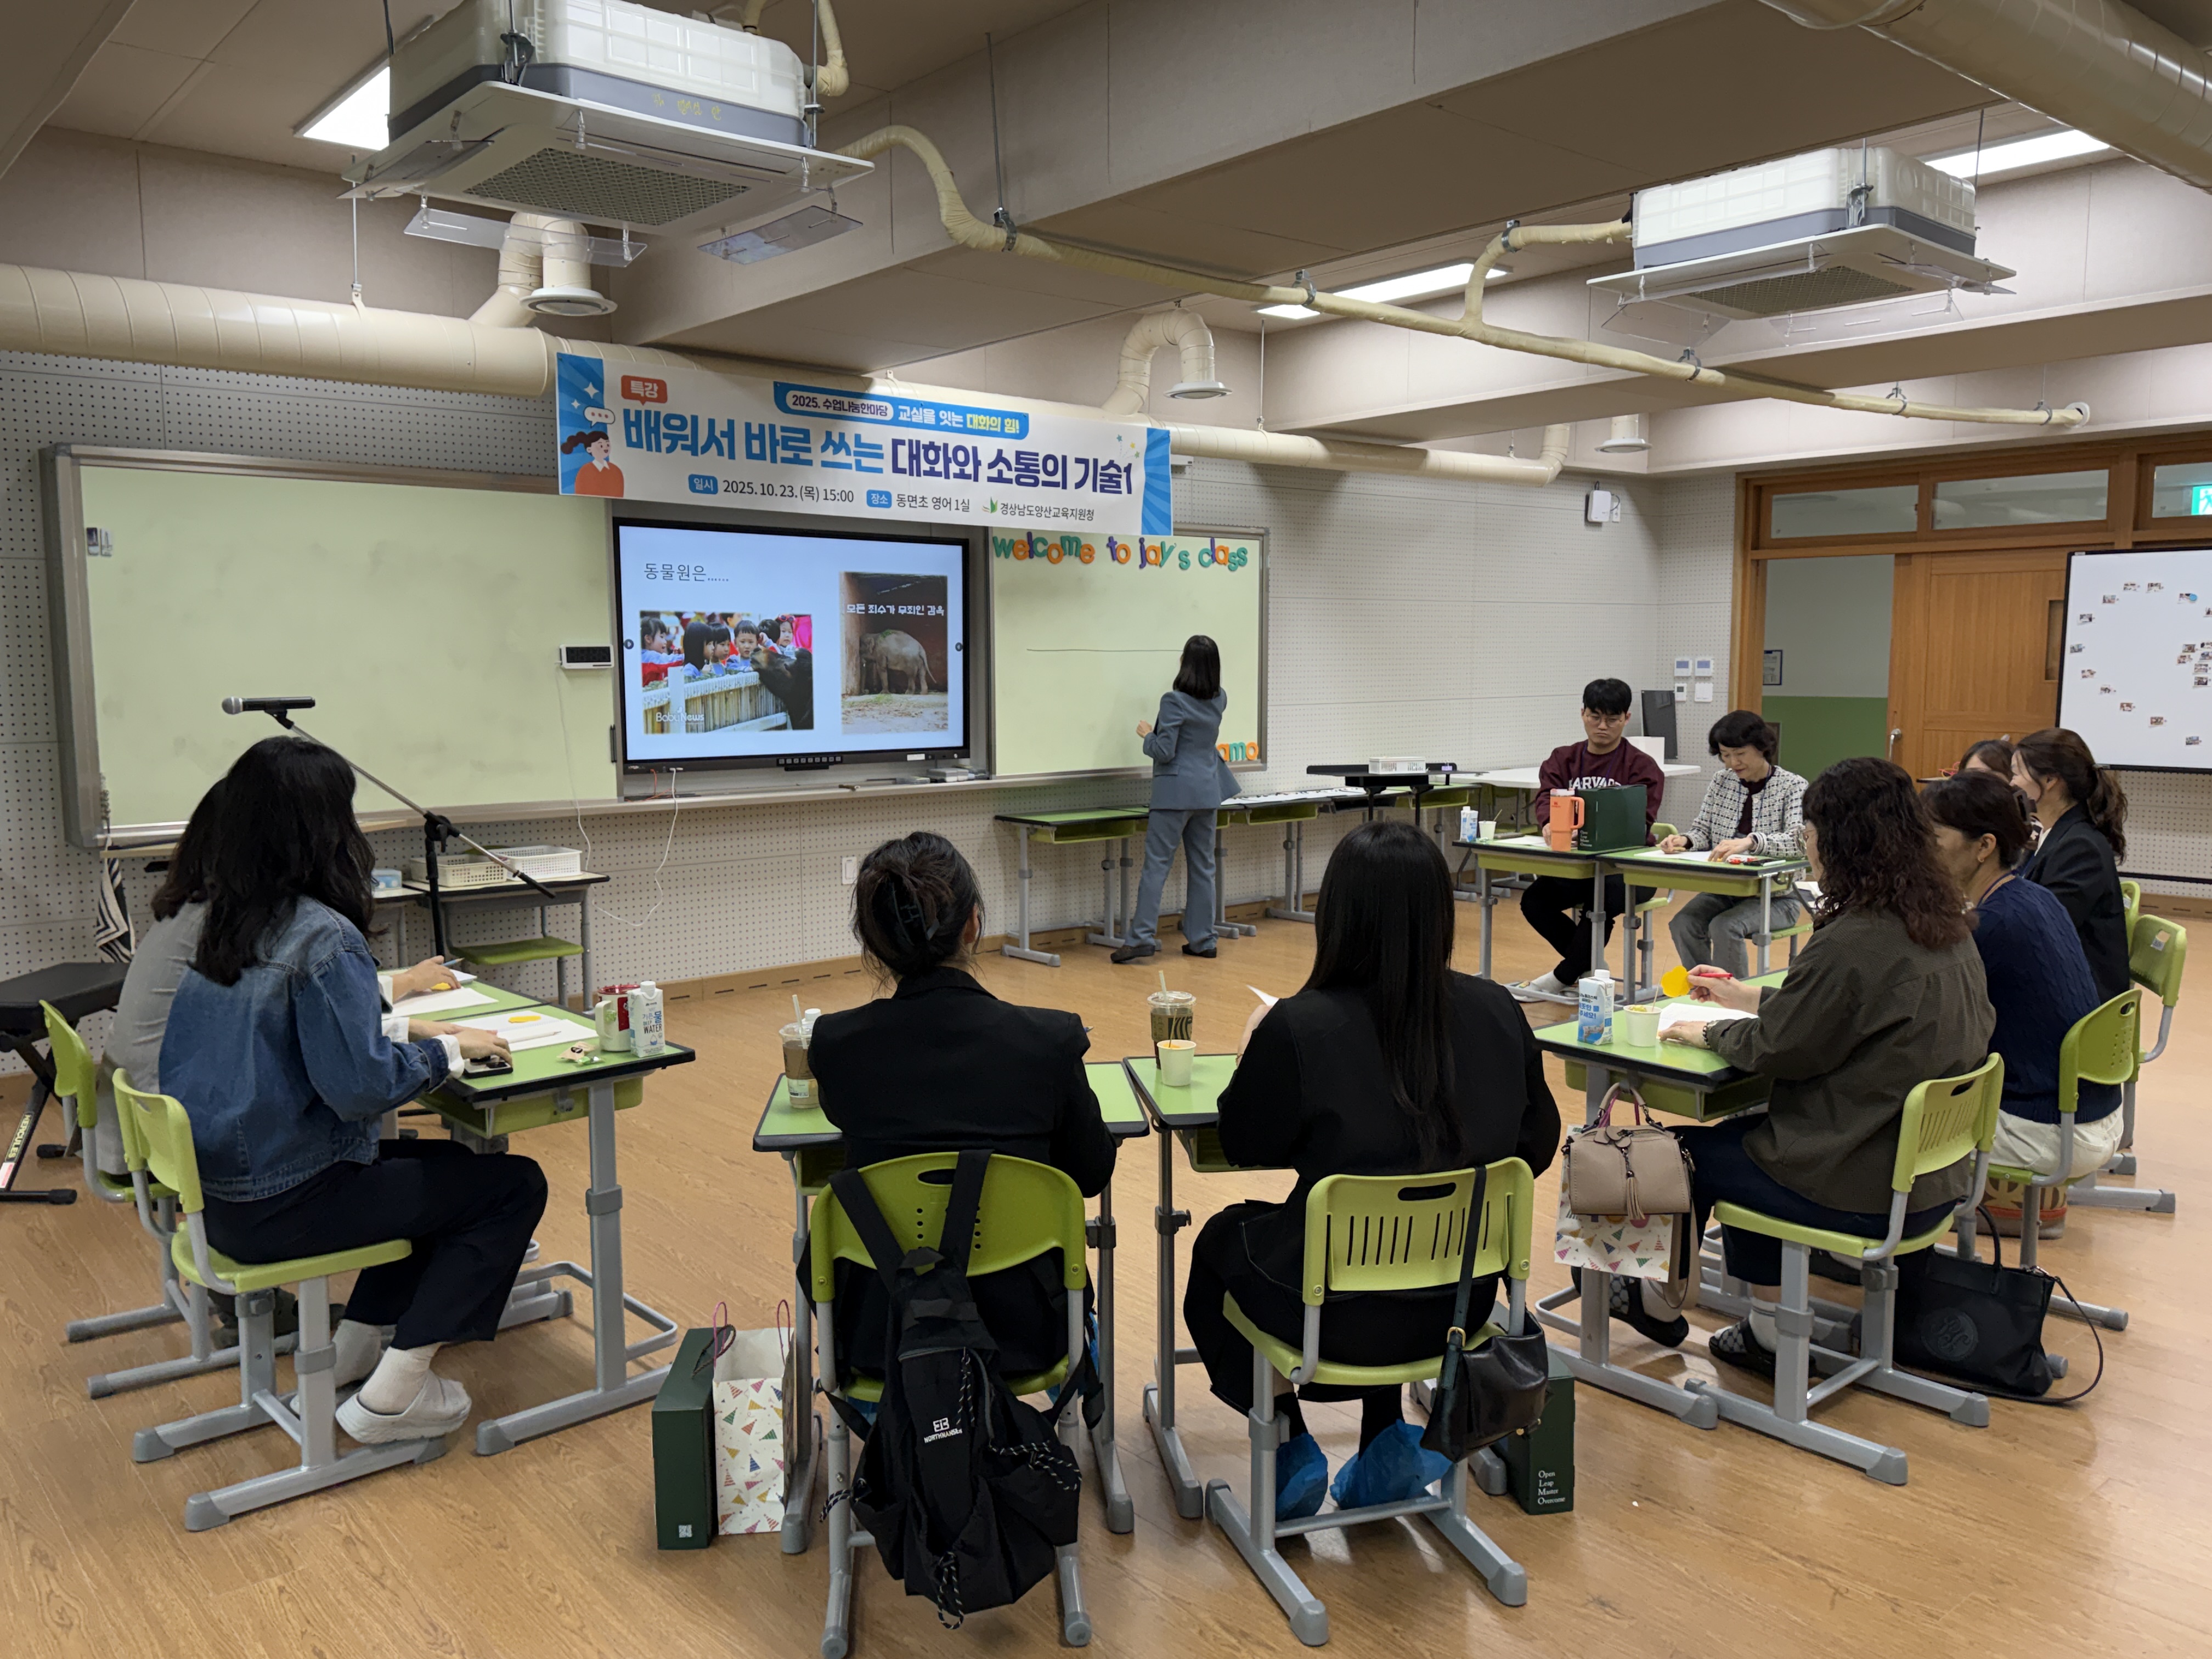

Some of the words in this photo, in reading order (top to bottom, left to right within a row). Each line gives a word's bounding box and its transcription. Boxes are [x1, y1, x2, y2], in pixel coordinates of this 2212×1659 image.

[630, 380, 659, 398] 특강
[792, 394, 820, 409] 2025.
[823, 398, 888, 417] 수업나눔한마당
[898, 404, 936, 425] 교실을
[939, 409, 963, 426] 잇는
[967, 414, 1002, 433] 대화의
[1005, 418, 1020, 434] 힘!
[623, 408, 736, 460] 배워서
[744, 421, 814, 467] 바로
[820, 430, 884, 474] 쓰는
[891, 438, 981, 482] 대화와
[987, 449, 1068, 490] 소통의
[693, 477, 714, 492] 일시
[823, 488, 854, 503] 15:00
[871, 493, 888, 505] 장소
[896, 493, 929, 509] 동면초
[931, 496, 952, 511] 영어
[1000, 502, 1094, 521] 경상남도양산교육지원청
[992, 532, 1096, 565] welcome
[1106, 535, 1131, 564] to
[1198, 537, 1248, 572] class
[847, 603, 866, 614] 모든
[868, 604, 895, 615] 죄수가
[898, 605, 925, 616] 무죄인
[927, 605, 945, 616] 감옥
[644, 1023, 663, 1034] WATER
[1538, 1470, 1556, 1479] Open
[1538, 1479, 1555, 1488] Leap
[1538, 1488, 1559, 1496] Master
[1537, 1497, 1566, 1505] Overcome
